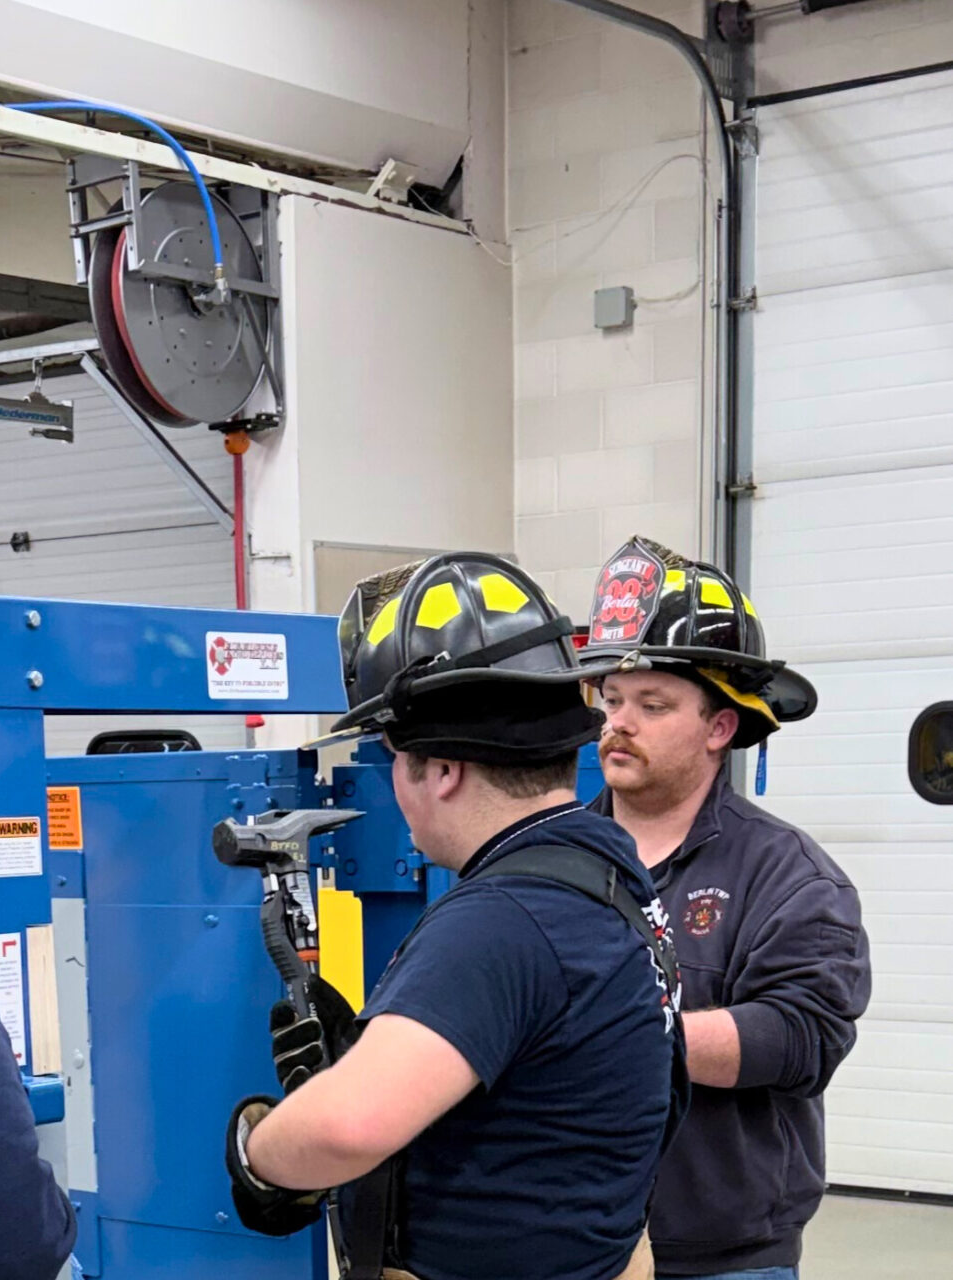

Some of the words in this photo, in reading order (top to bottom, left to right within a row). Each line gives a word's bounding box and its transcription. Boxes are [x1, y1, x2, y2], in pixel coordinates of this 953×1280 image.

[609, 558, 650, 578] SERGEANT
[601, 593, 640, 610] Berlin
[687, 888, 715, 901] BERLIN
